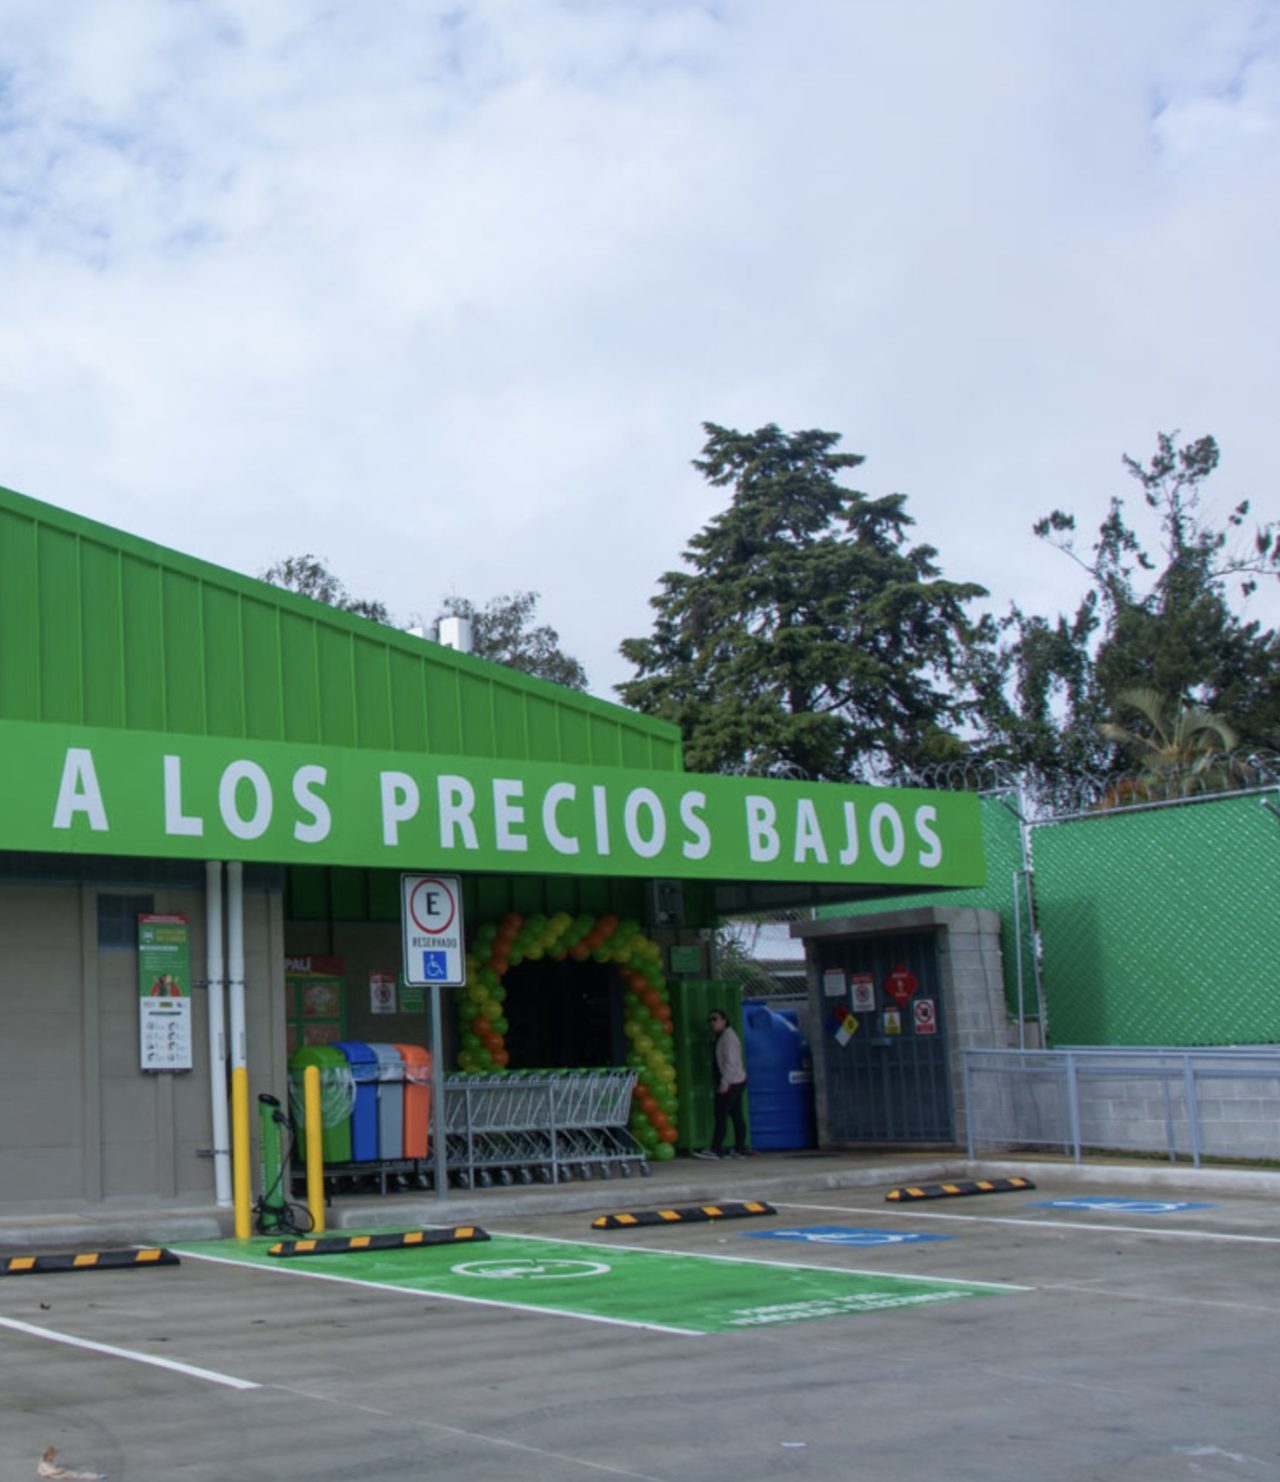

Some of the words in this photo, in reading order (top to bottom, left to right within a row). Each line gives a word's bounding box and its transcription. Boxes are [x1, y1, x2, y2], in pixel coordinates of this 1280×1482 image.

[53, 748, 109, 831] A
[163, 754, 332, 843] LOS
[380, 771, 712, 860] PRECIOS
[745, 795, 943, 868] BAJOS
[426, 892, 441, 915] E
[412, 937, 457, 949] RESERVADO
